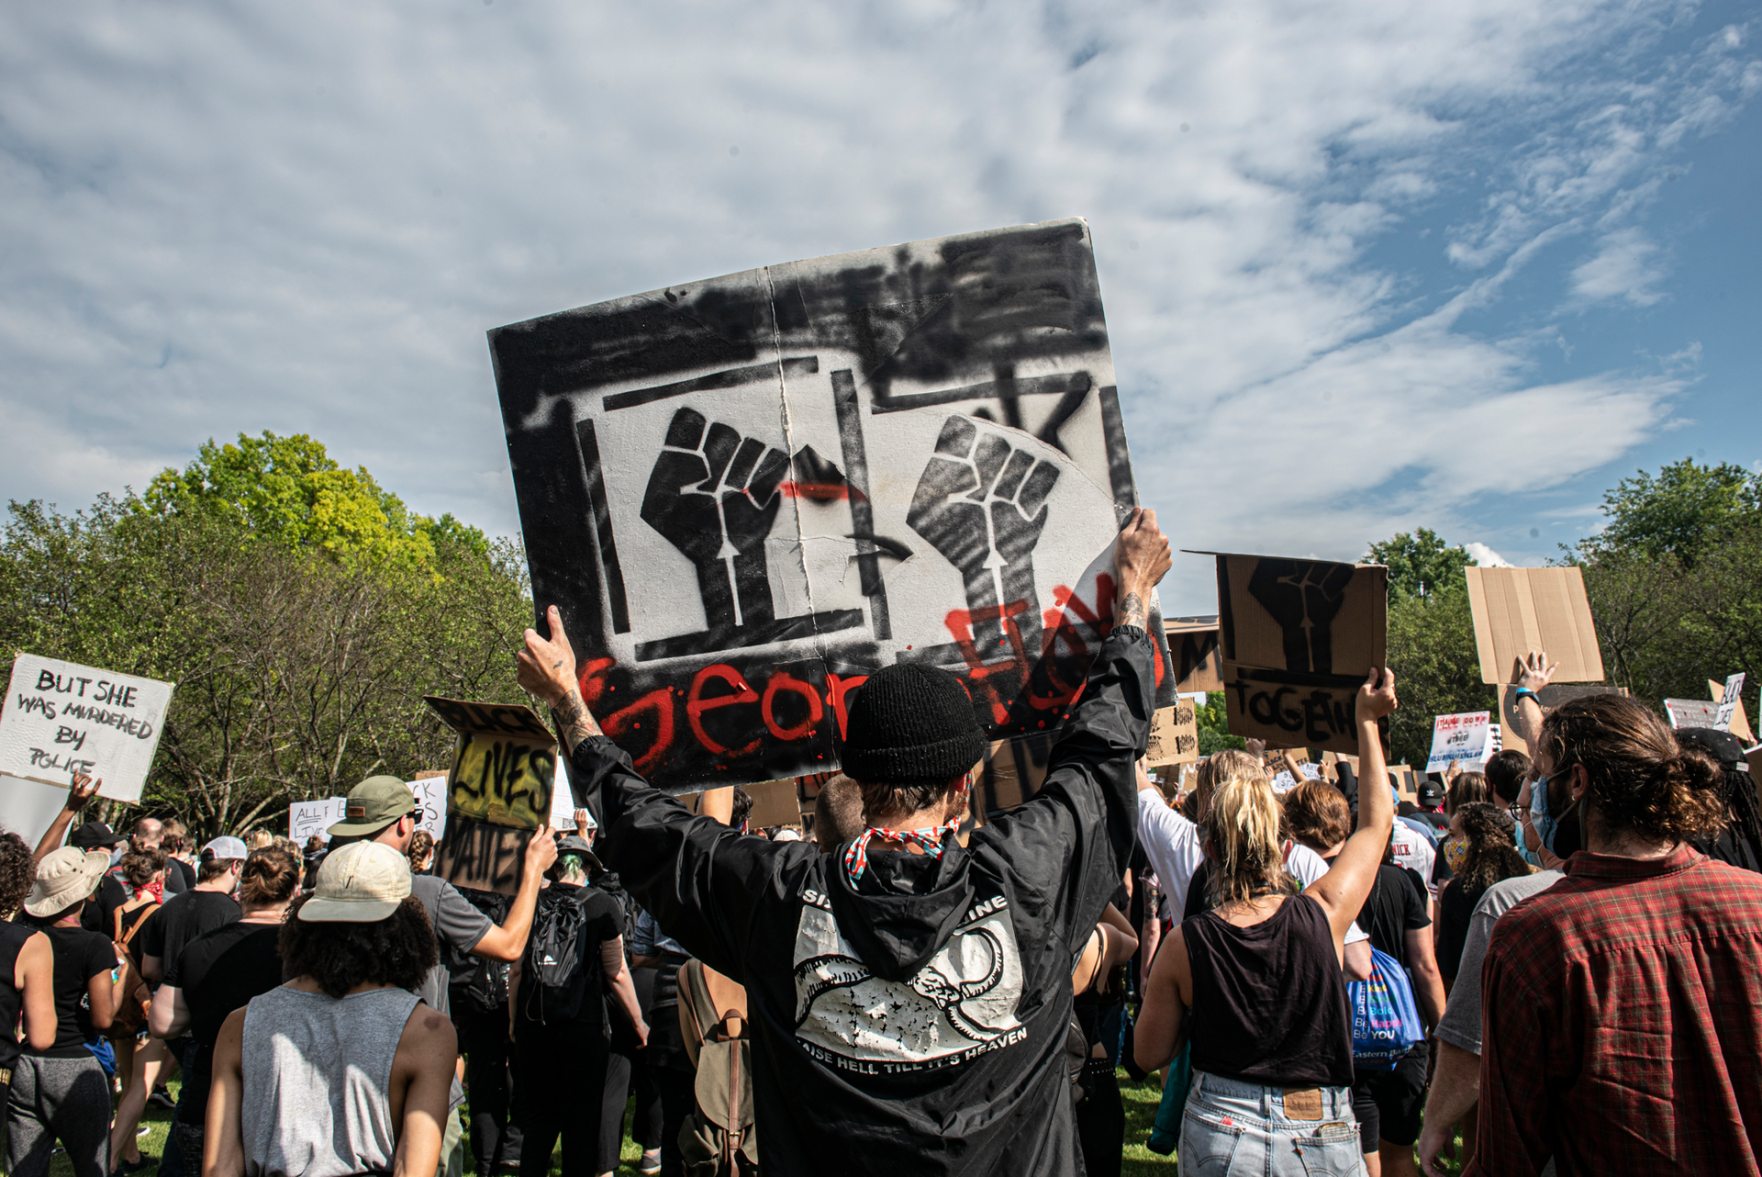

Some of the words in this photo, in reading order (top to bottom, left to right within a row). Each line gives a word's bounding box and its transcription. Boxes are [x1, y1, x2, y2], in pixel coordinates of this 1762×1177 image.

[35, 669, 93, 697] BUT
[93, 680, 138, 708] SHE
[18, 693, 56, 720] WAS
[62, 702, 153, 739] MURDERED
[54, 725, 87, 751] BY
[29, 747, 96, 775] POLICE
[451, 732, 555, 815] LIVES
[295, 807, 321, 822] ALL
[966, 895, 1007, 921] INE
[1353, 1029, 1368, 1040] Be
[1371, 1030, 1395, 1040] YOU
[1371, 1017, 1402, 1029] Happy
[799, 1041, 833, 1064] AISE
[837, 1058, 879, 1075] HELL
[883, 1063, 923, 1074] TILL
[928, 1053, 960, 1068] IT'S
[965, 1027, 1028, 1060] HEAVEN
